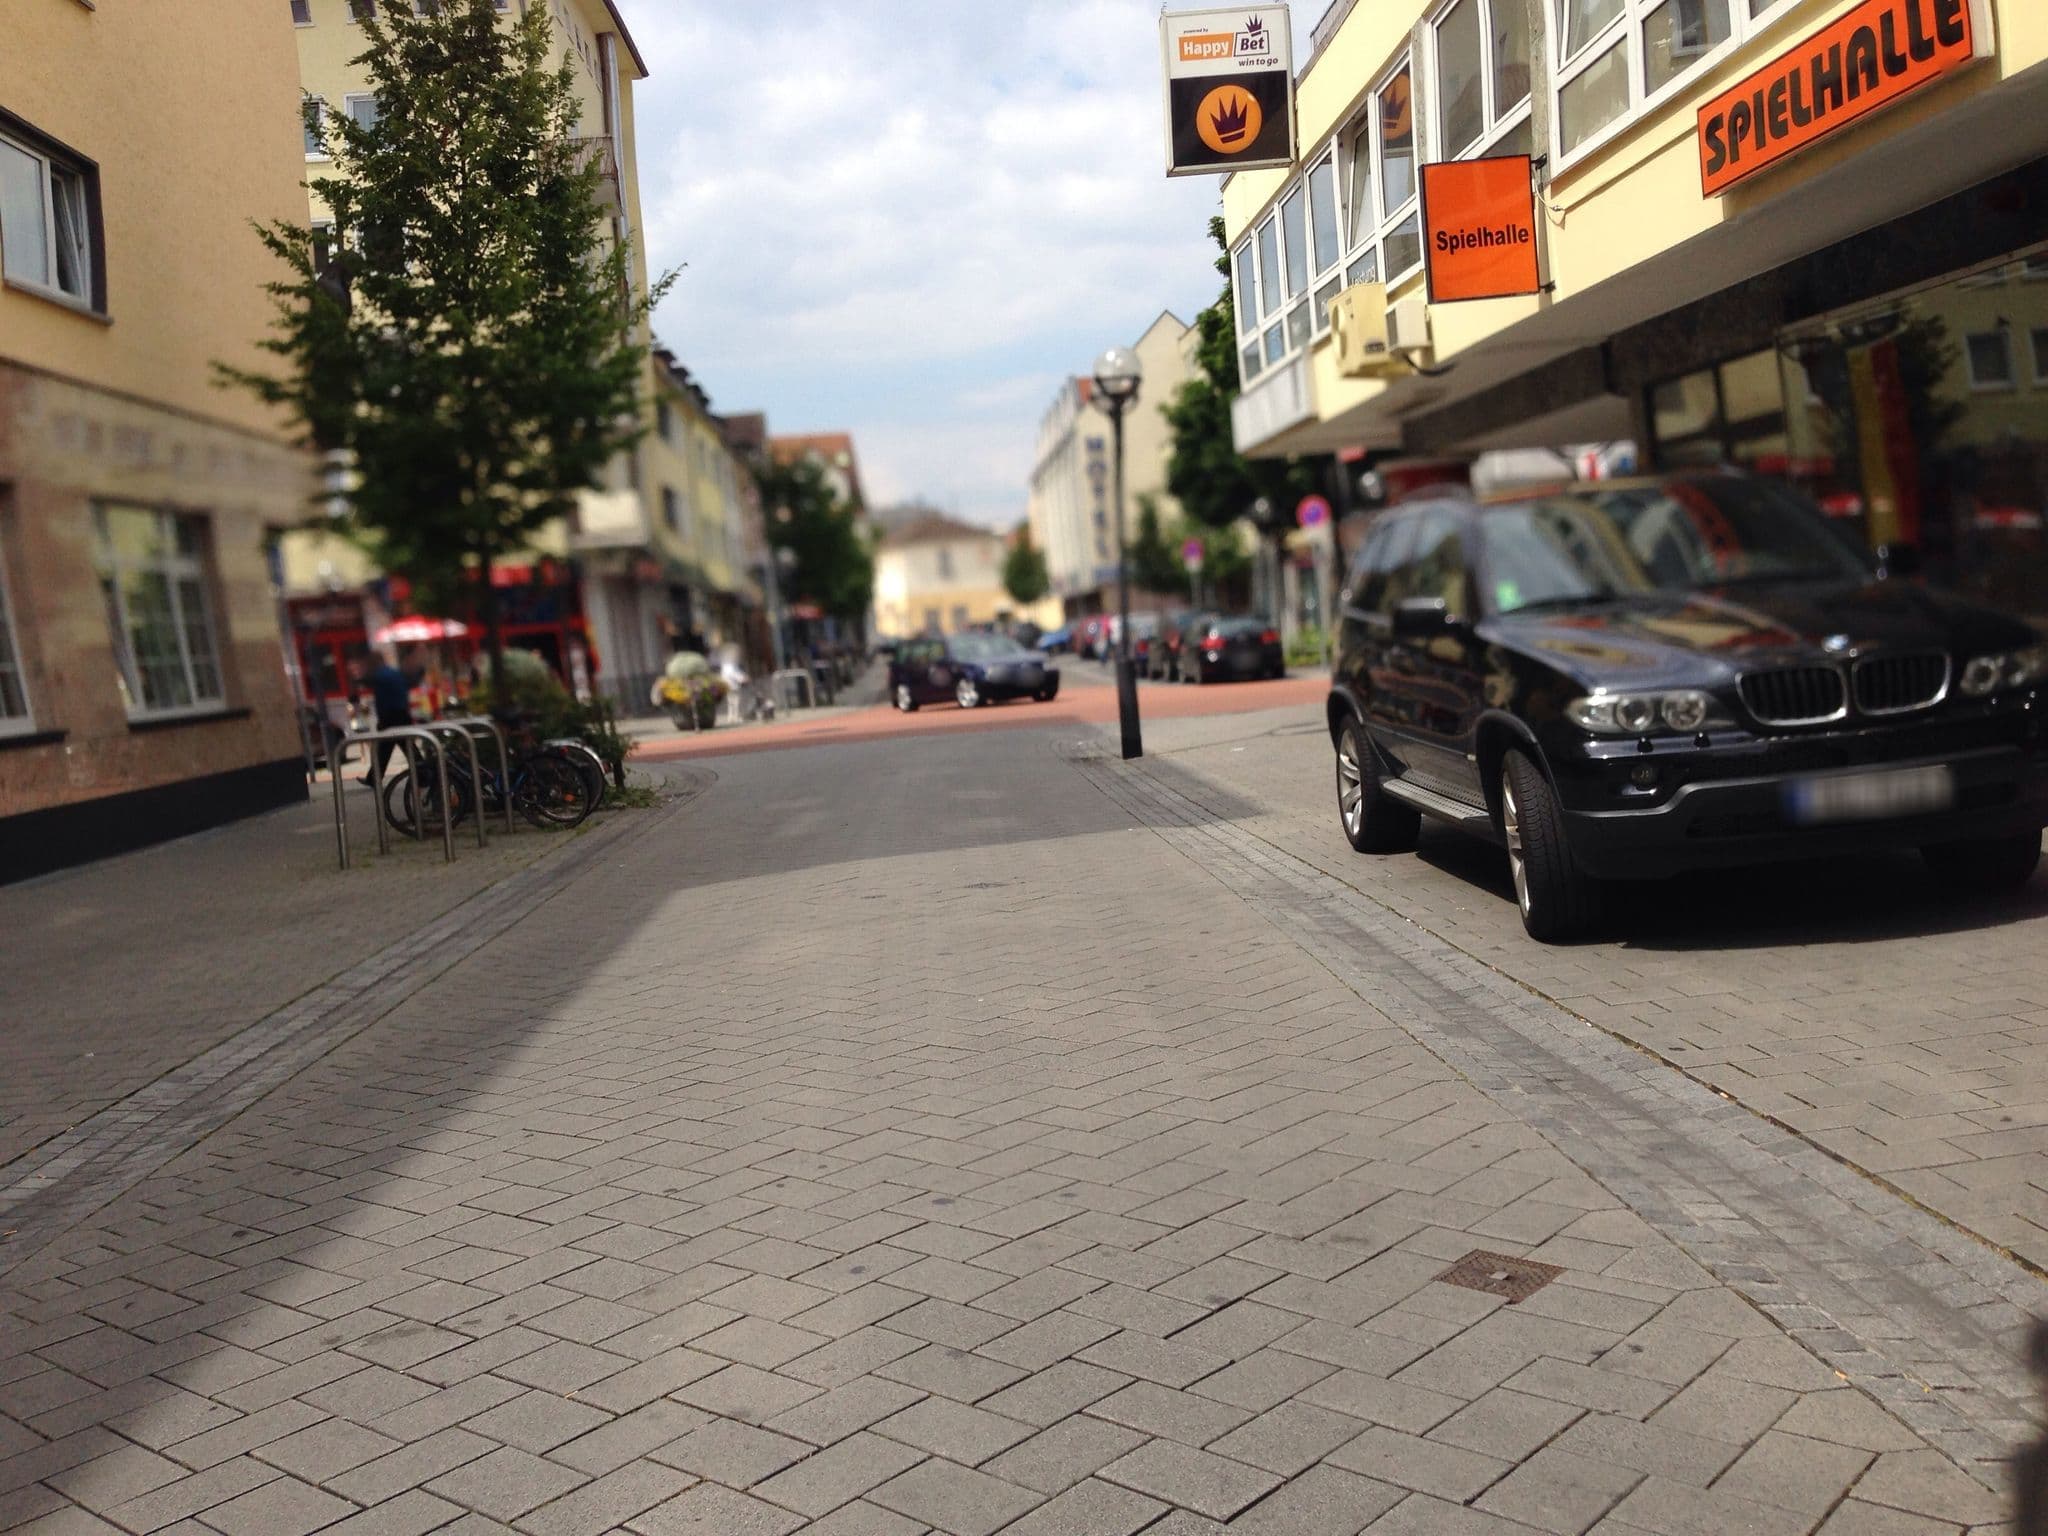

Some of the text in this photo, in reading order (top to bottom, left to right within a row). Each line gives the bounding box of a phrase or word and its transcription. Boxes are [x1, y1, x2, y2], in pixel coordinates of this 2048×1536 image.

[1183, 37, 1264, 56] Happy Bet
[1238, 57, 1279, 67] win to go
[1705, 0, 1964, 176] SPIELHALLE
[1436, 224, 1529, 255] Spielhalle
